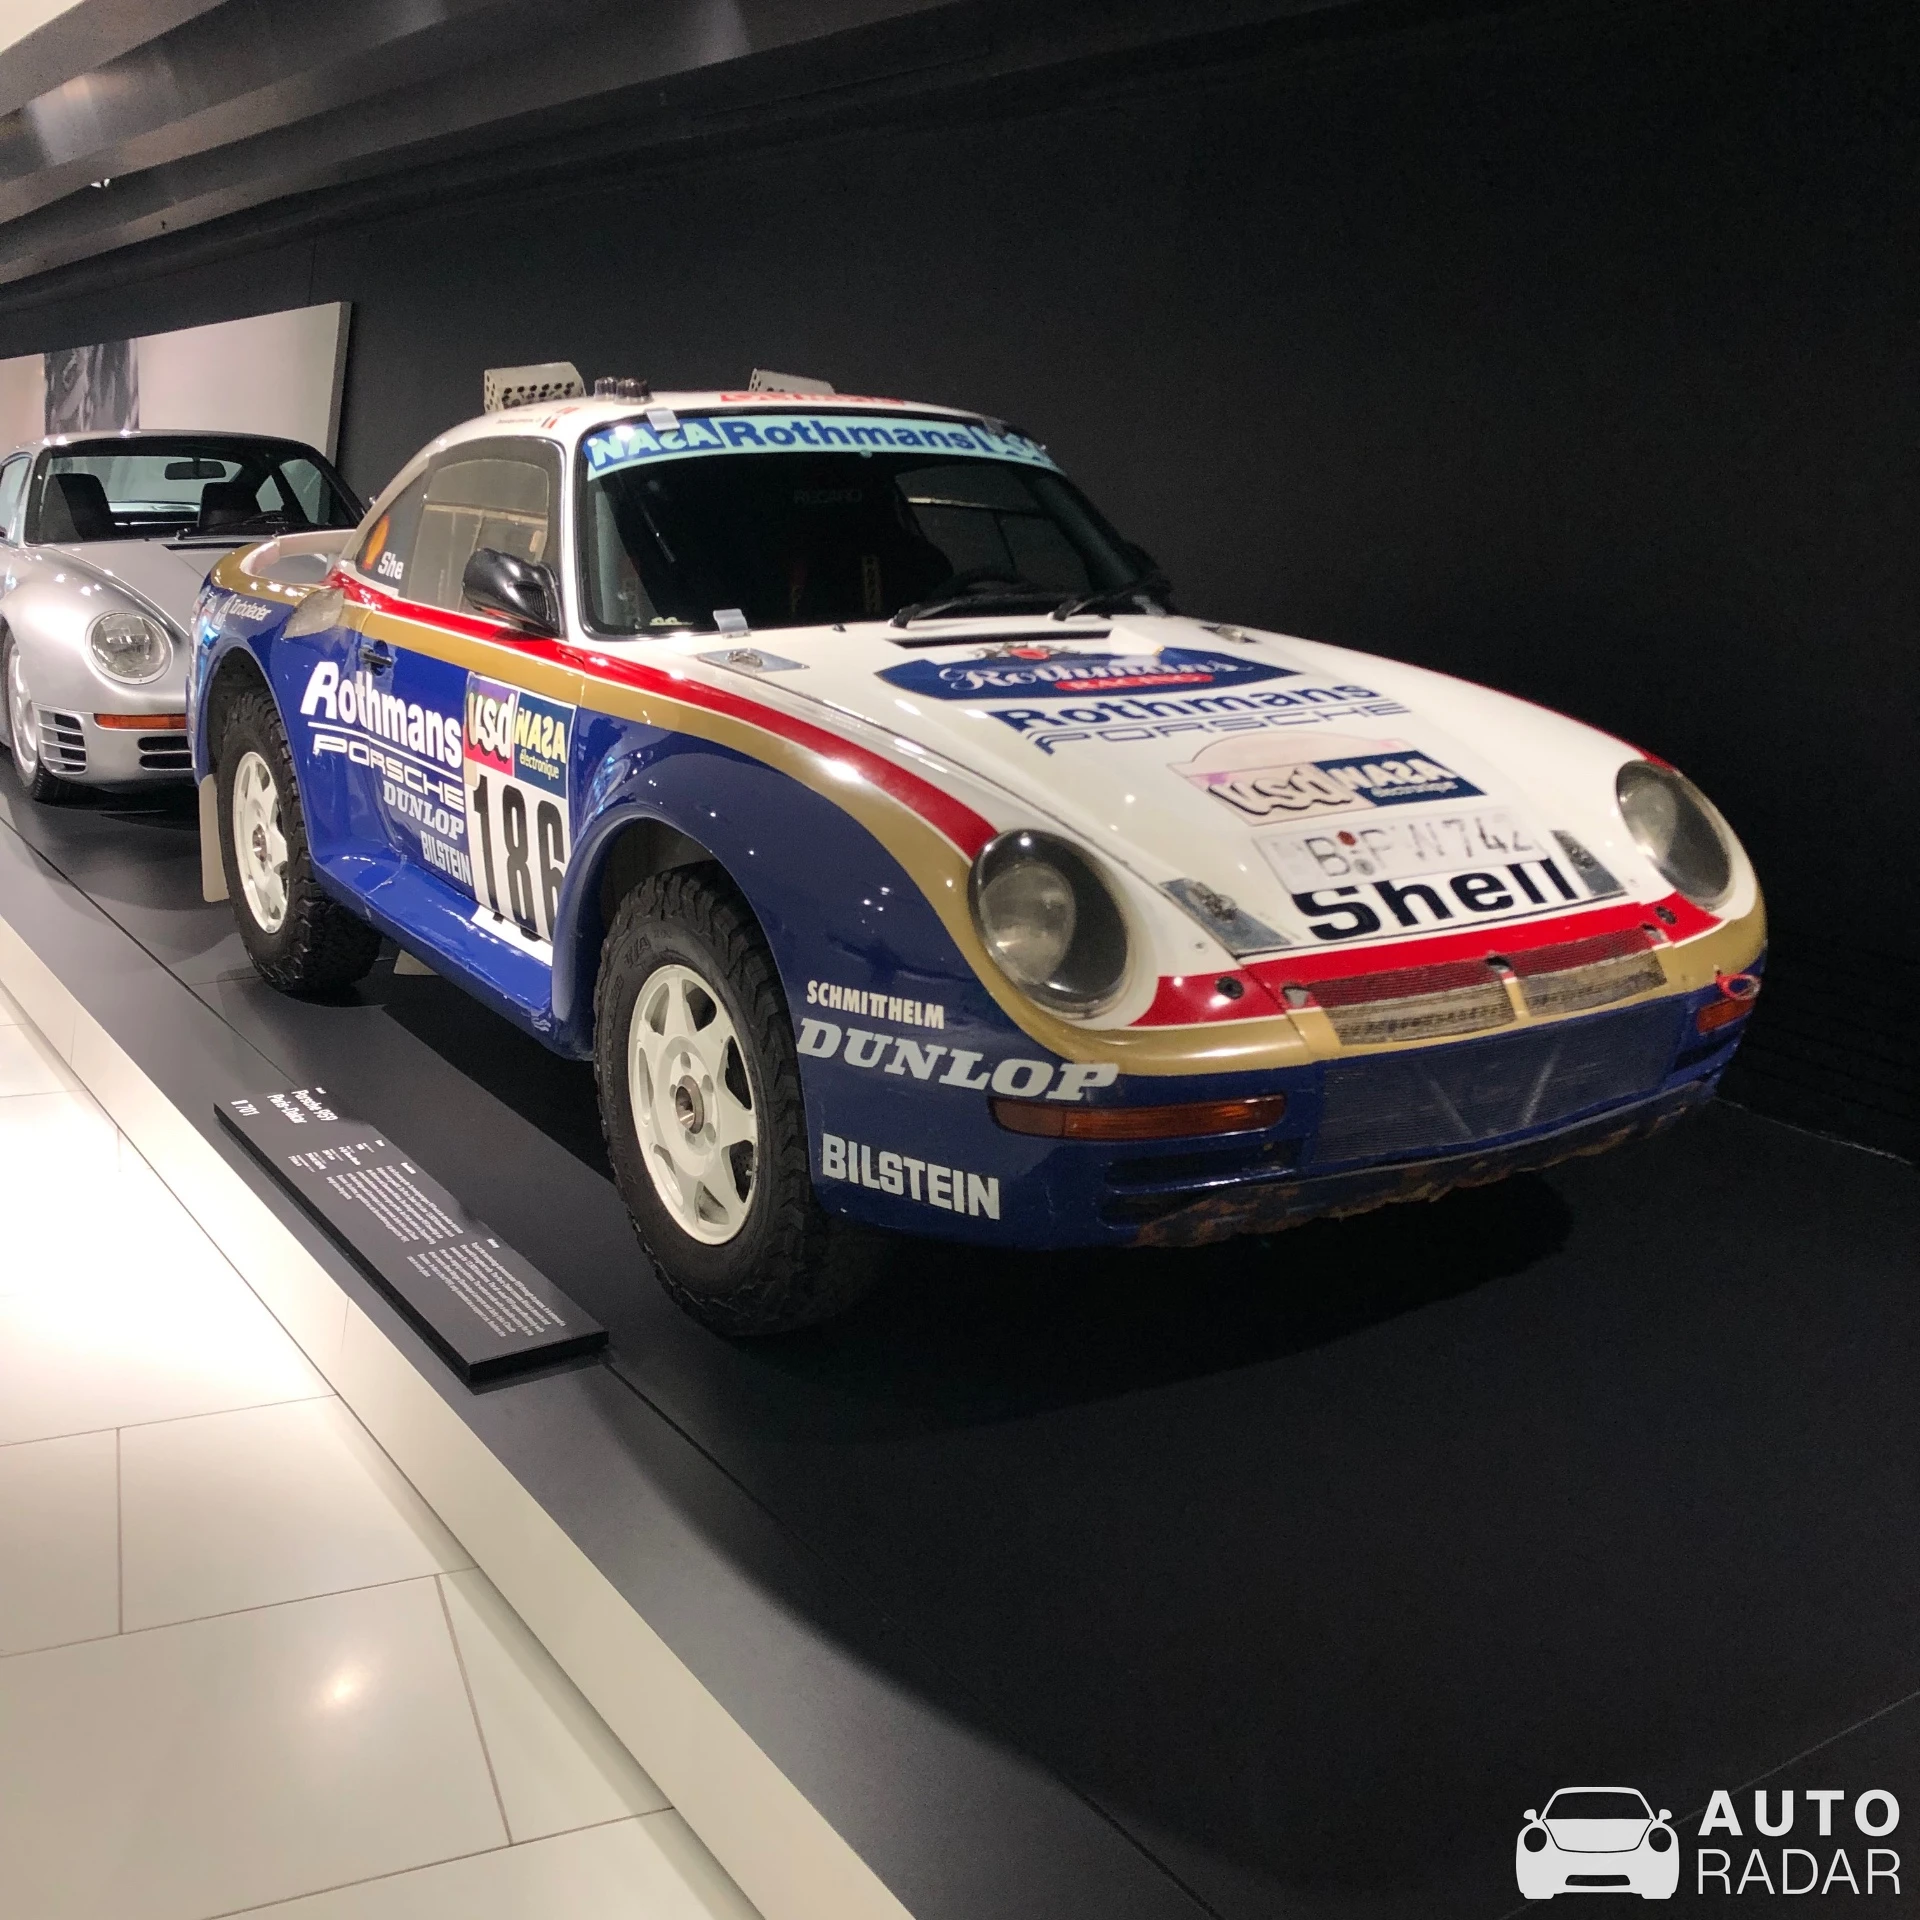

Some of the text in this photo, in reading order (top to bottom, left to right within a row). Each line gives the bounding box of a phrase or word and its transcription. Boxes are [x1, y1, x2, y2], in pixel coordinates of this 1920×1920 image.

[719, 419, 980, 450] Rothmans
[938, 660, 1253, 691] Rothmans
[300, 661, 462, 769] Rothmans
[992, 683, 1382, 733] Rothmans
[1033, 700, 1411, 755] PORSCHE
[312, 733, 465, 813] PORSCHE
[383, 779, 465, 841] DUNLOP
[421, 829, 472, 887] BILSTEIN
[474, 774, 566, 942] 186
[1291, 857, 1583, 941] Shell
[805, 979, 945, 1031] SCHMITTHELM
[797, 1016, 1120, 1102] DUNLOP
[267, 1093, 308, 1124] Paris-Dakar
[291, 1089, 323, 1113] Porsche
[312, 1107, 339, 1122] 959
[821, 1132, 1001, 1221] BILSTEIN
